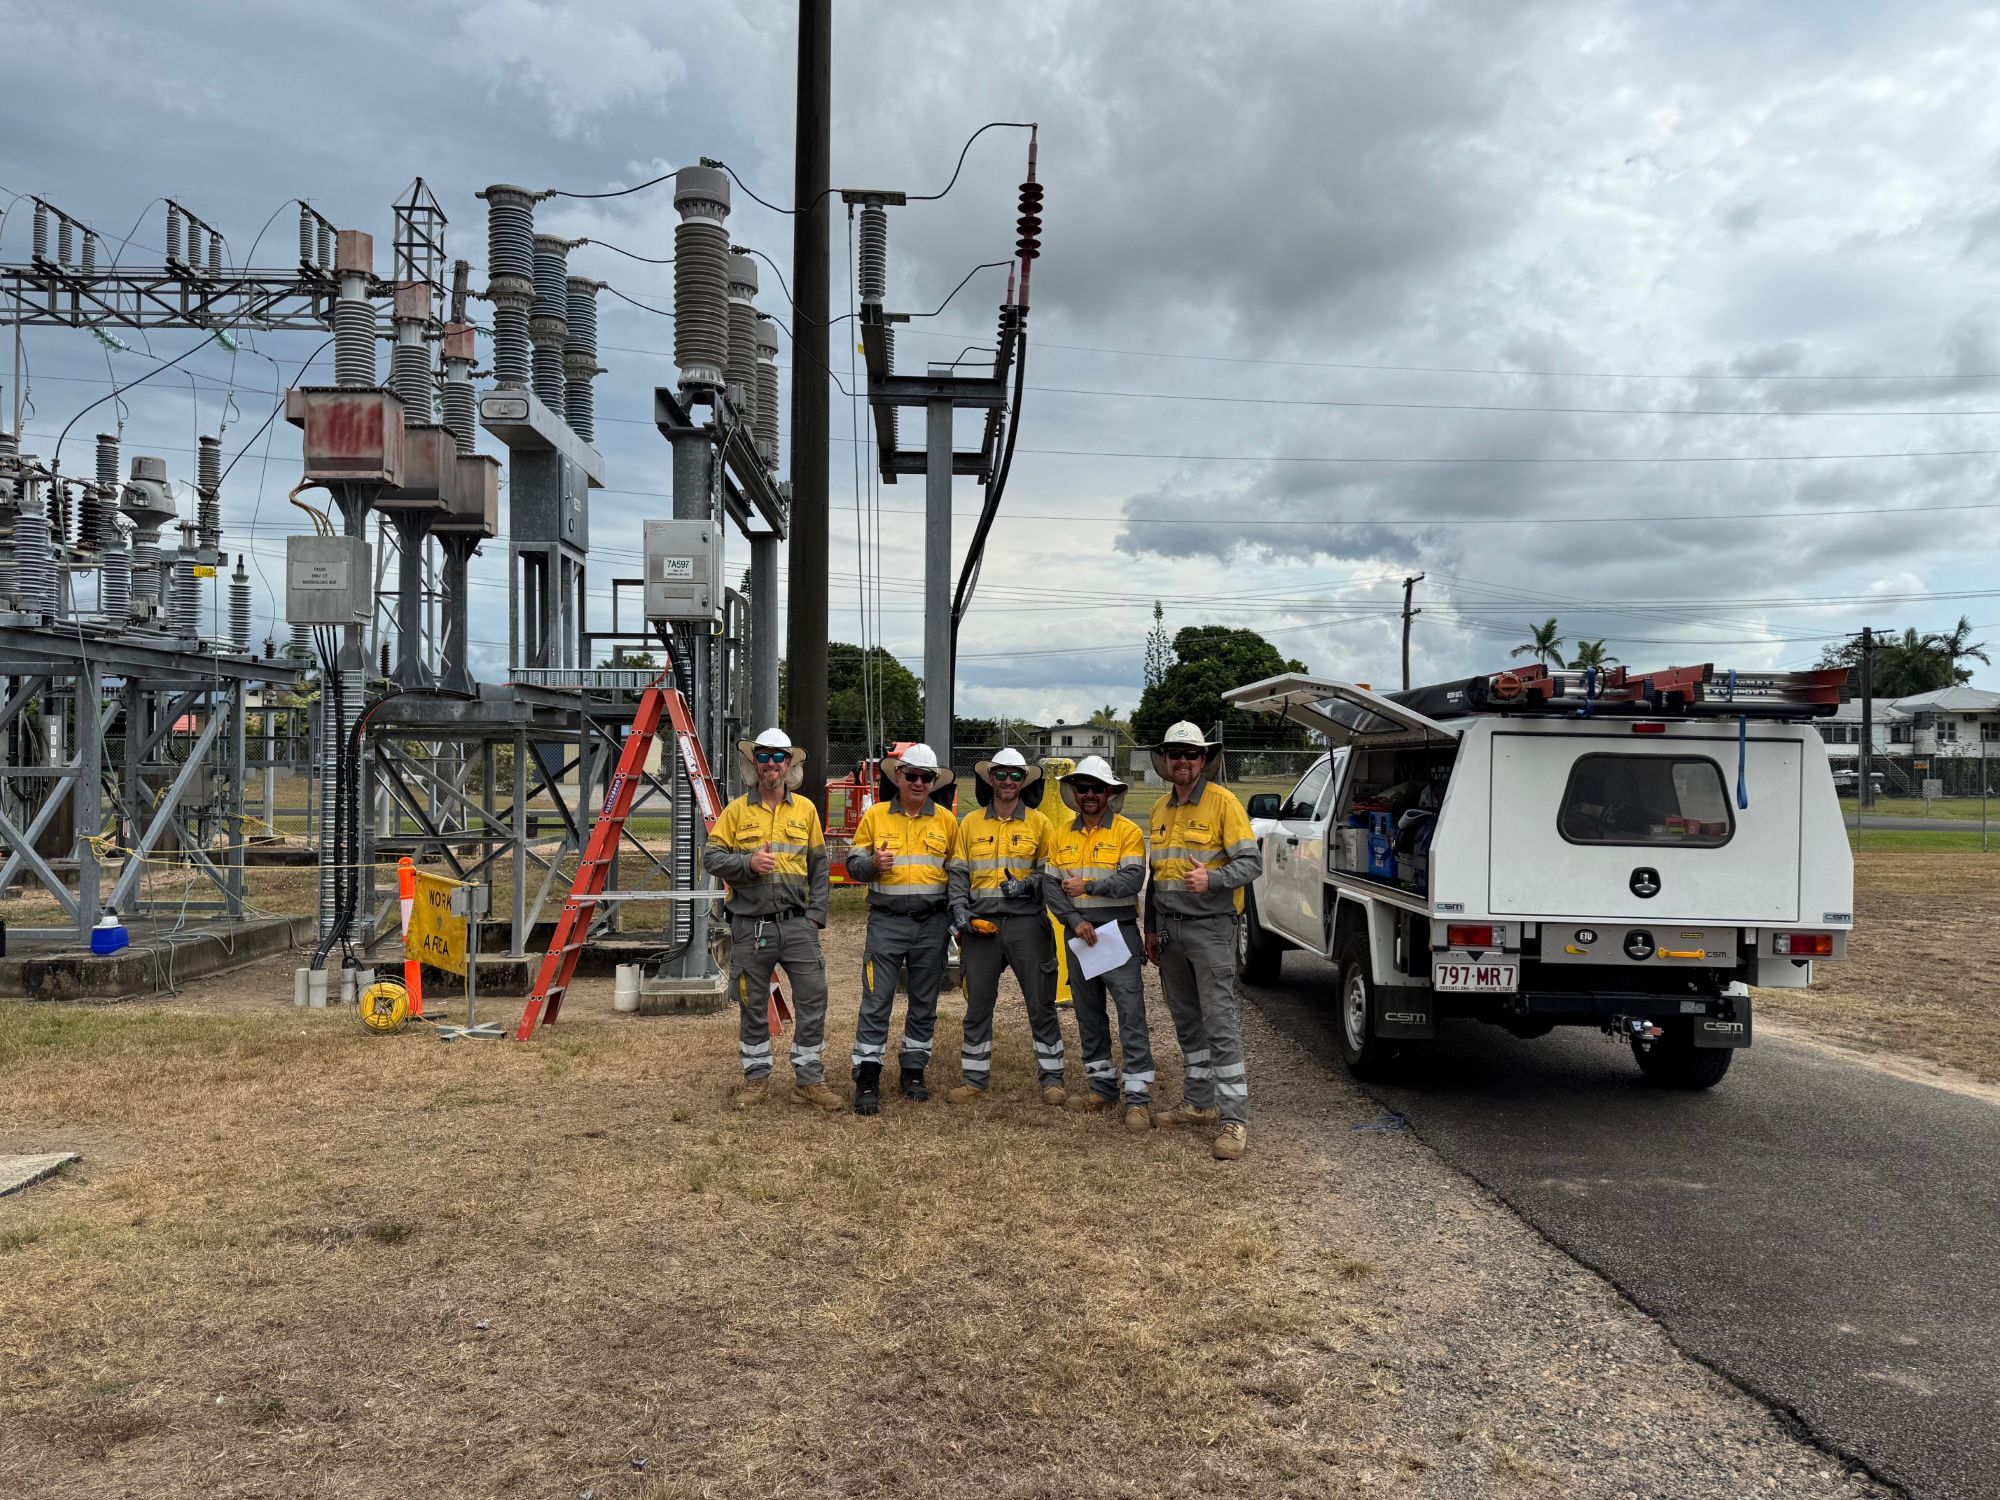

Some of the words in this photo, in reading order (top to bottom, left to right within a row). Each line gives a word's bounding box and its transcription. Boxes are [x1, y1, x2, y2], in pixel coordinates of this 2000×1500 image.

[666, 560, 690, 569] 7A597
[428, 889, 452, 912] WORK
[1579, 932, 1593, 941] ETU
[423, 933, 450, 957] AREA
